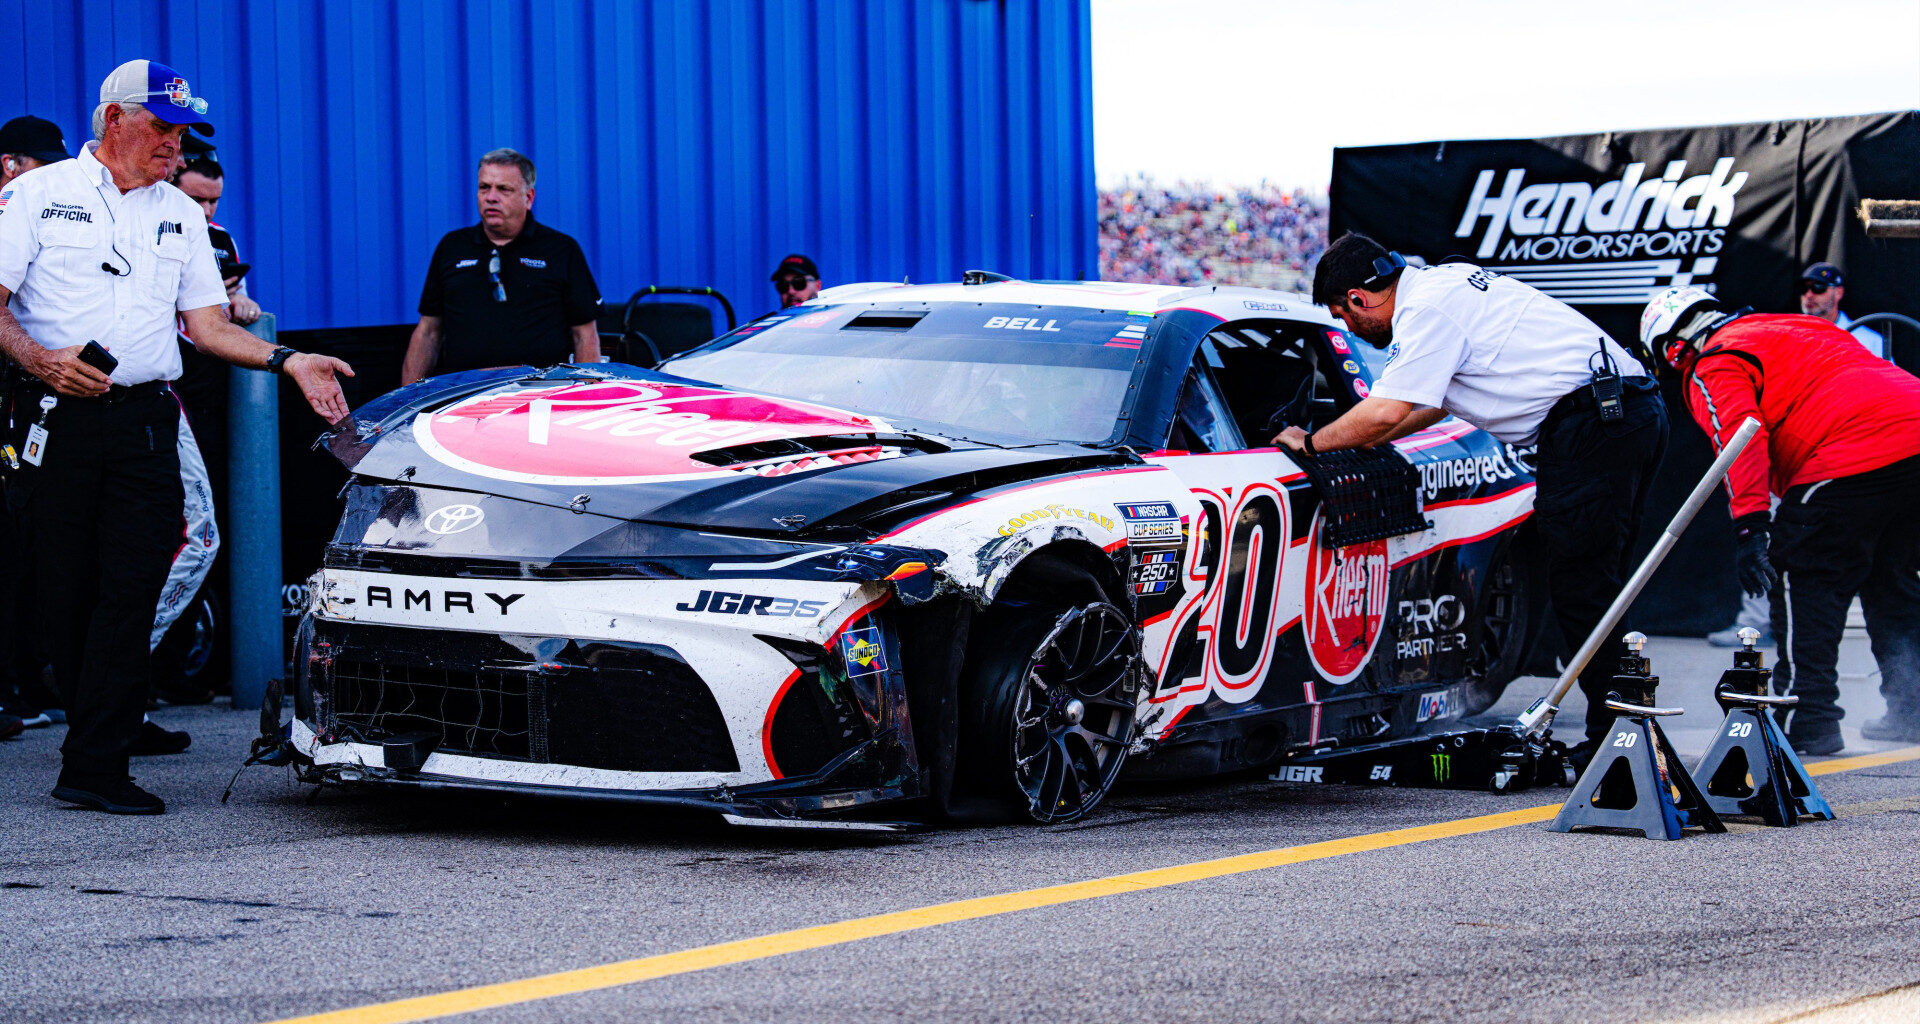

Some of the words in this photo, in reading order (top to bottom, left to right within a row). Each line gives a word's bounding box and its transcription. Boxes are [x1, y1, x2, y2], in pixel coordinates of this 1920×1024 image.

[41, 208, 93, 223] OFFICIAL
[1455, 157, 1749, 258] Hendrick
[1499, 228, 1727, 260] MOTORSPORTS
[983, 316, 1061, 332] BELL
[1416, 446, 1517, 500] ngineered
[1138, 504, 1170, 517] NASCAR
[998, 503, 1115, 537] GOODYEAR
[1133, 524, 1148, 536] CUP
[1148, 523, 1174, 535] SERIES
[1140, 563, 1168, 581] 250
[1310, 516, 1386, 647] Rheem
[328, 585, 526, 615] AMRY
[1154, 485, 1288, 698] 20
[1398, 594, 1466, 635] PRO
[849, 644, 879, 660] SUNOCO
[1727, 722, 1753, 738] 20
[1612, 731, 1638, 748] 20
[1268, 765, 1324, 783] JGR
[1369, 765, 1393, 781] 54
